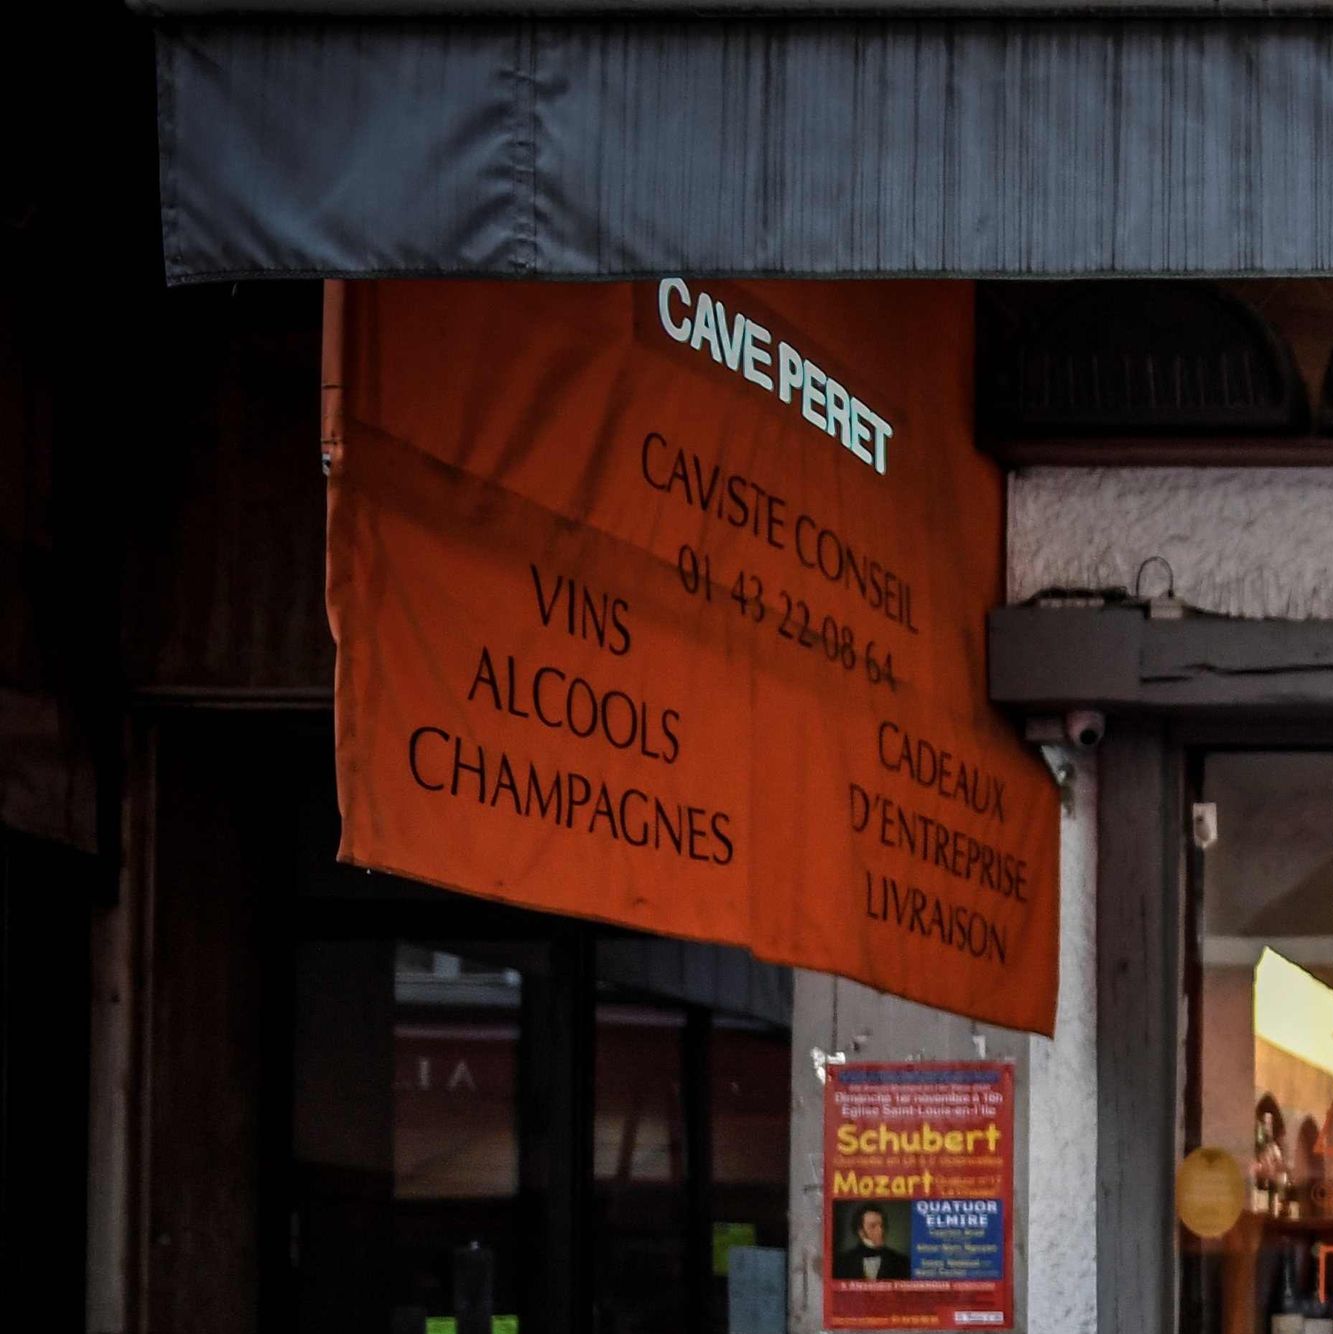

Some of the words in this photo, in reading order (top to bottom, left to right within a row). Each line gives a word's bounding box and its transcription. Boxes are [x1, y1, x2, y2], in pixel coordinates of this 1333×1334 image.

[658, 276, 773, 392] CAVE
[778, 340, 893, 476] PERET
[641, 432, 786, 550] CAVISTE
[796, 513, 920, 636] CONSEIL
[530, 563, 632, 657] VINS
[678, 544, 713, 603] 01
[730, 571, 767, 625] 43
[864, 641, 898, 693] 64
[468, 646, 681, 766] ALCOOLS
[408, 726, 734, 867] CHAMPAGNES
[877, 721, 1008, 822] CADEAUX
[848, 782, 1029, 902] D'ENTREPRISE
[865, 871, 1008, 965] LIVRAISON
[832, 1169, 935, 1198] Mozart
[836, 1121, 1001, 1156] Schubert
[915, 1199, 998, 1216] QUATUOR
[925, 1213, 989, 1228] ELMIRE
